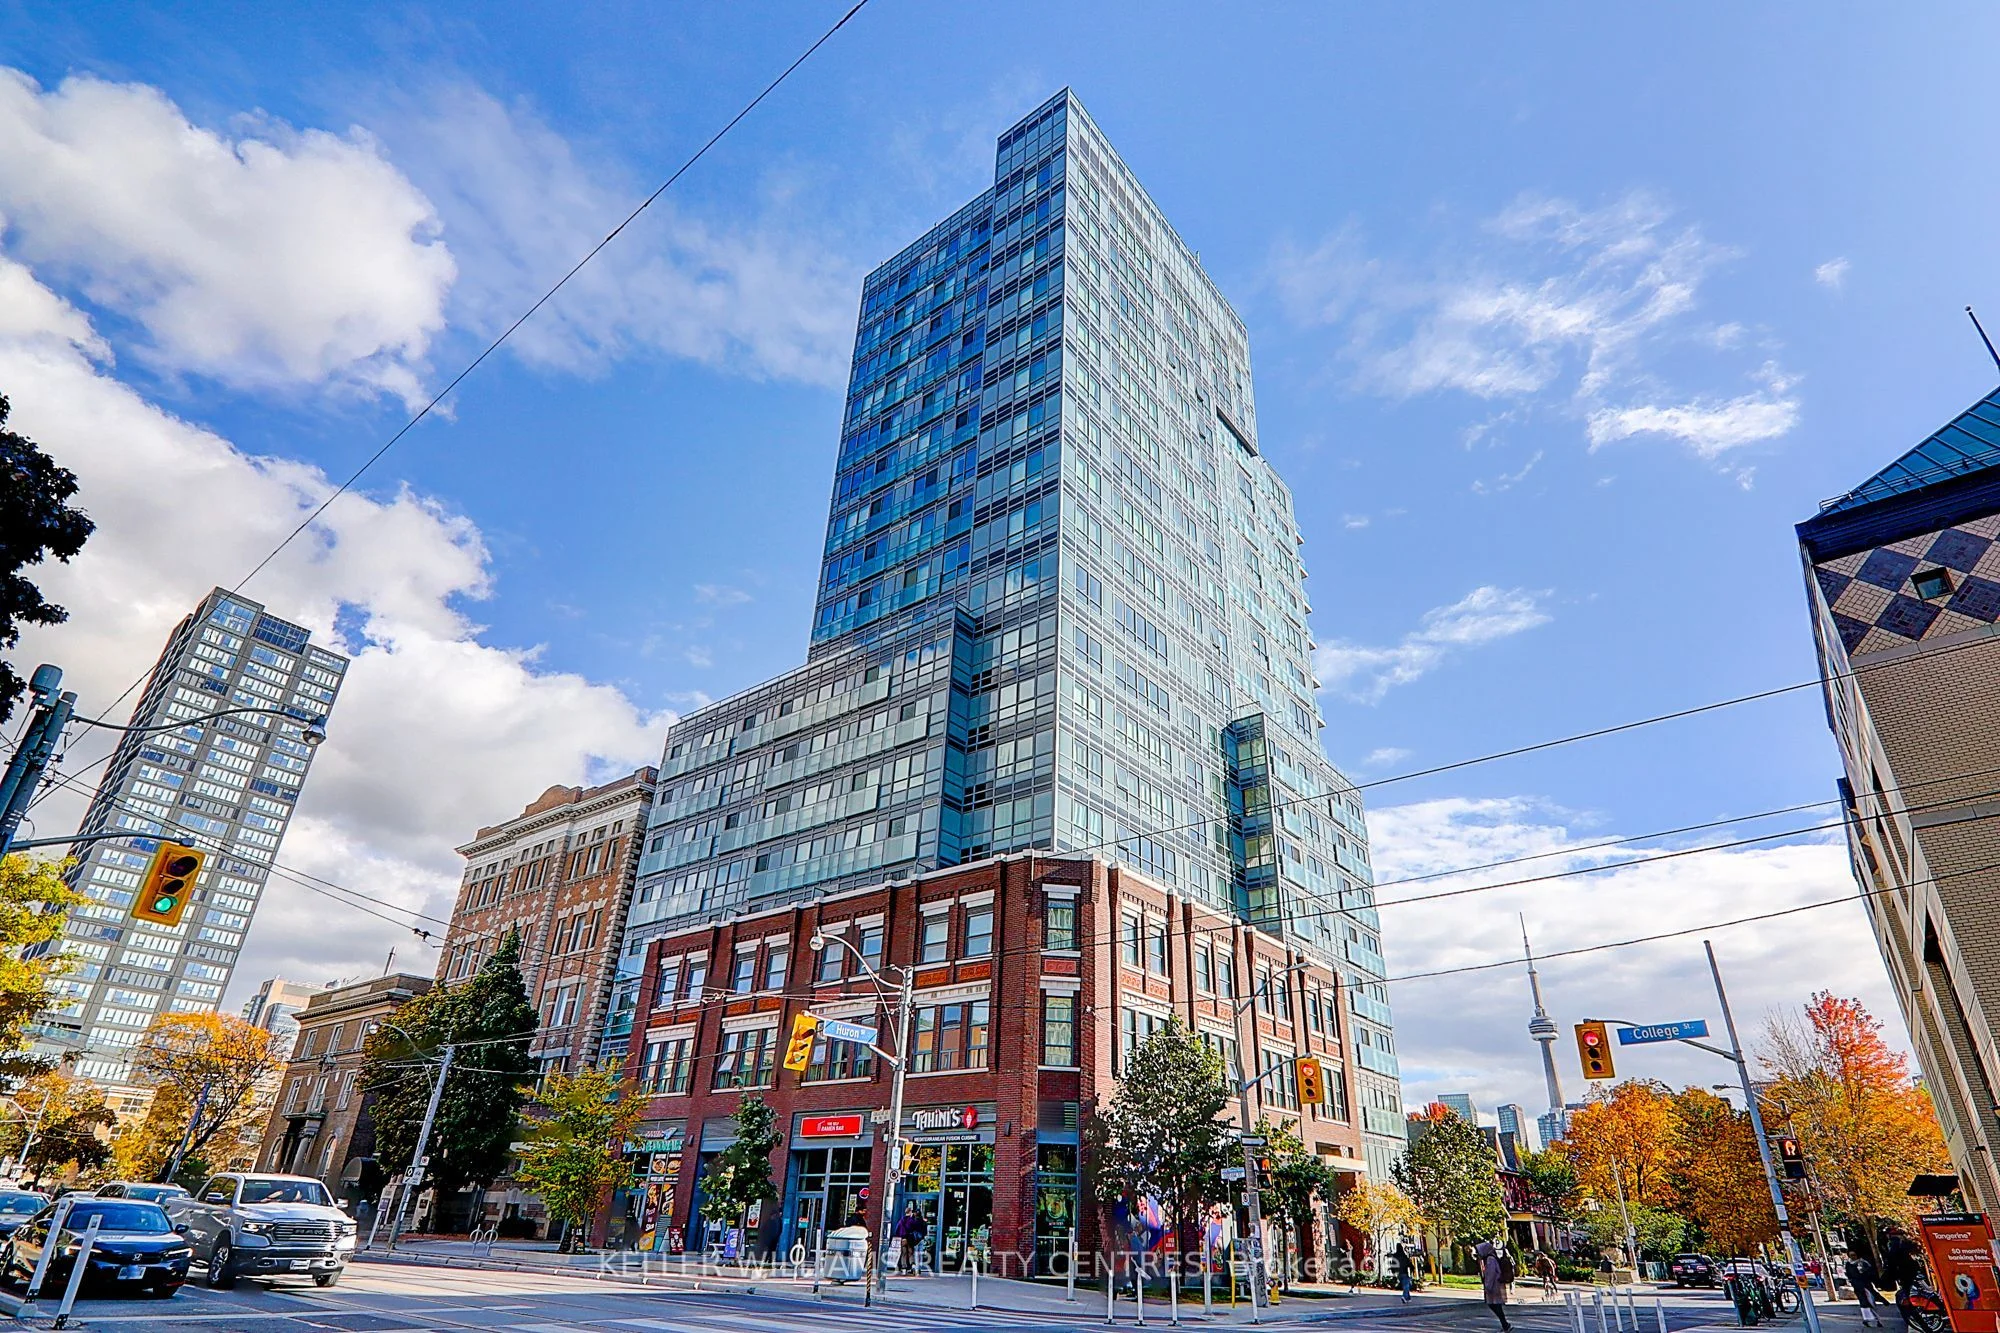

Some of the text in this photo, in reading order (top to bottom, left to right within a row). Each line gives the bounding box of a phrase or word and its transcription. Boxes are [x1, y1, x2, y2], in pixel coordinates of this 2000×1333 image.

[836, 1024, 860, 1038] Huron
[1633, 1026, 1680, 1039] College
[1828, 1235, 1839, 1243] 30
[1932, 1232, 1970, 1240] Tangerine
[1961, 1247, 1988, 1255] monthly
